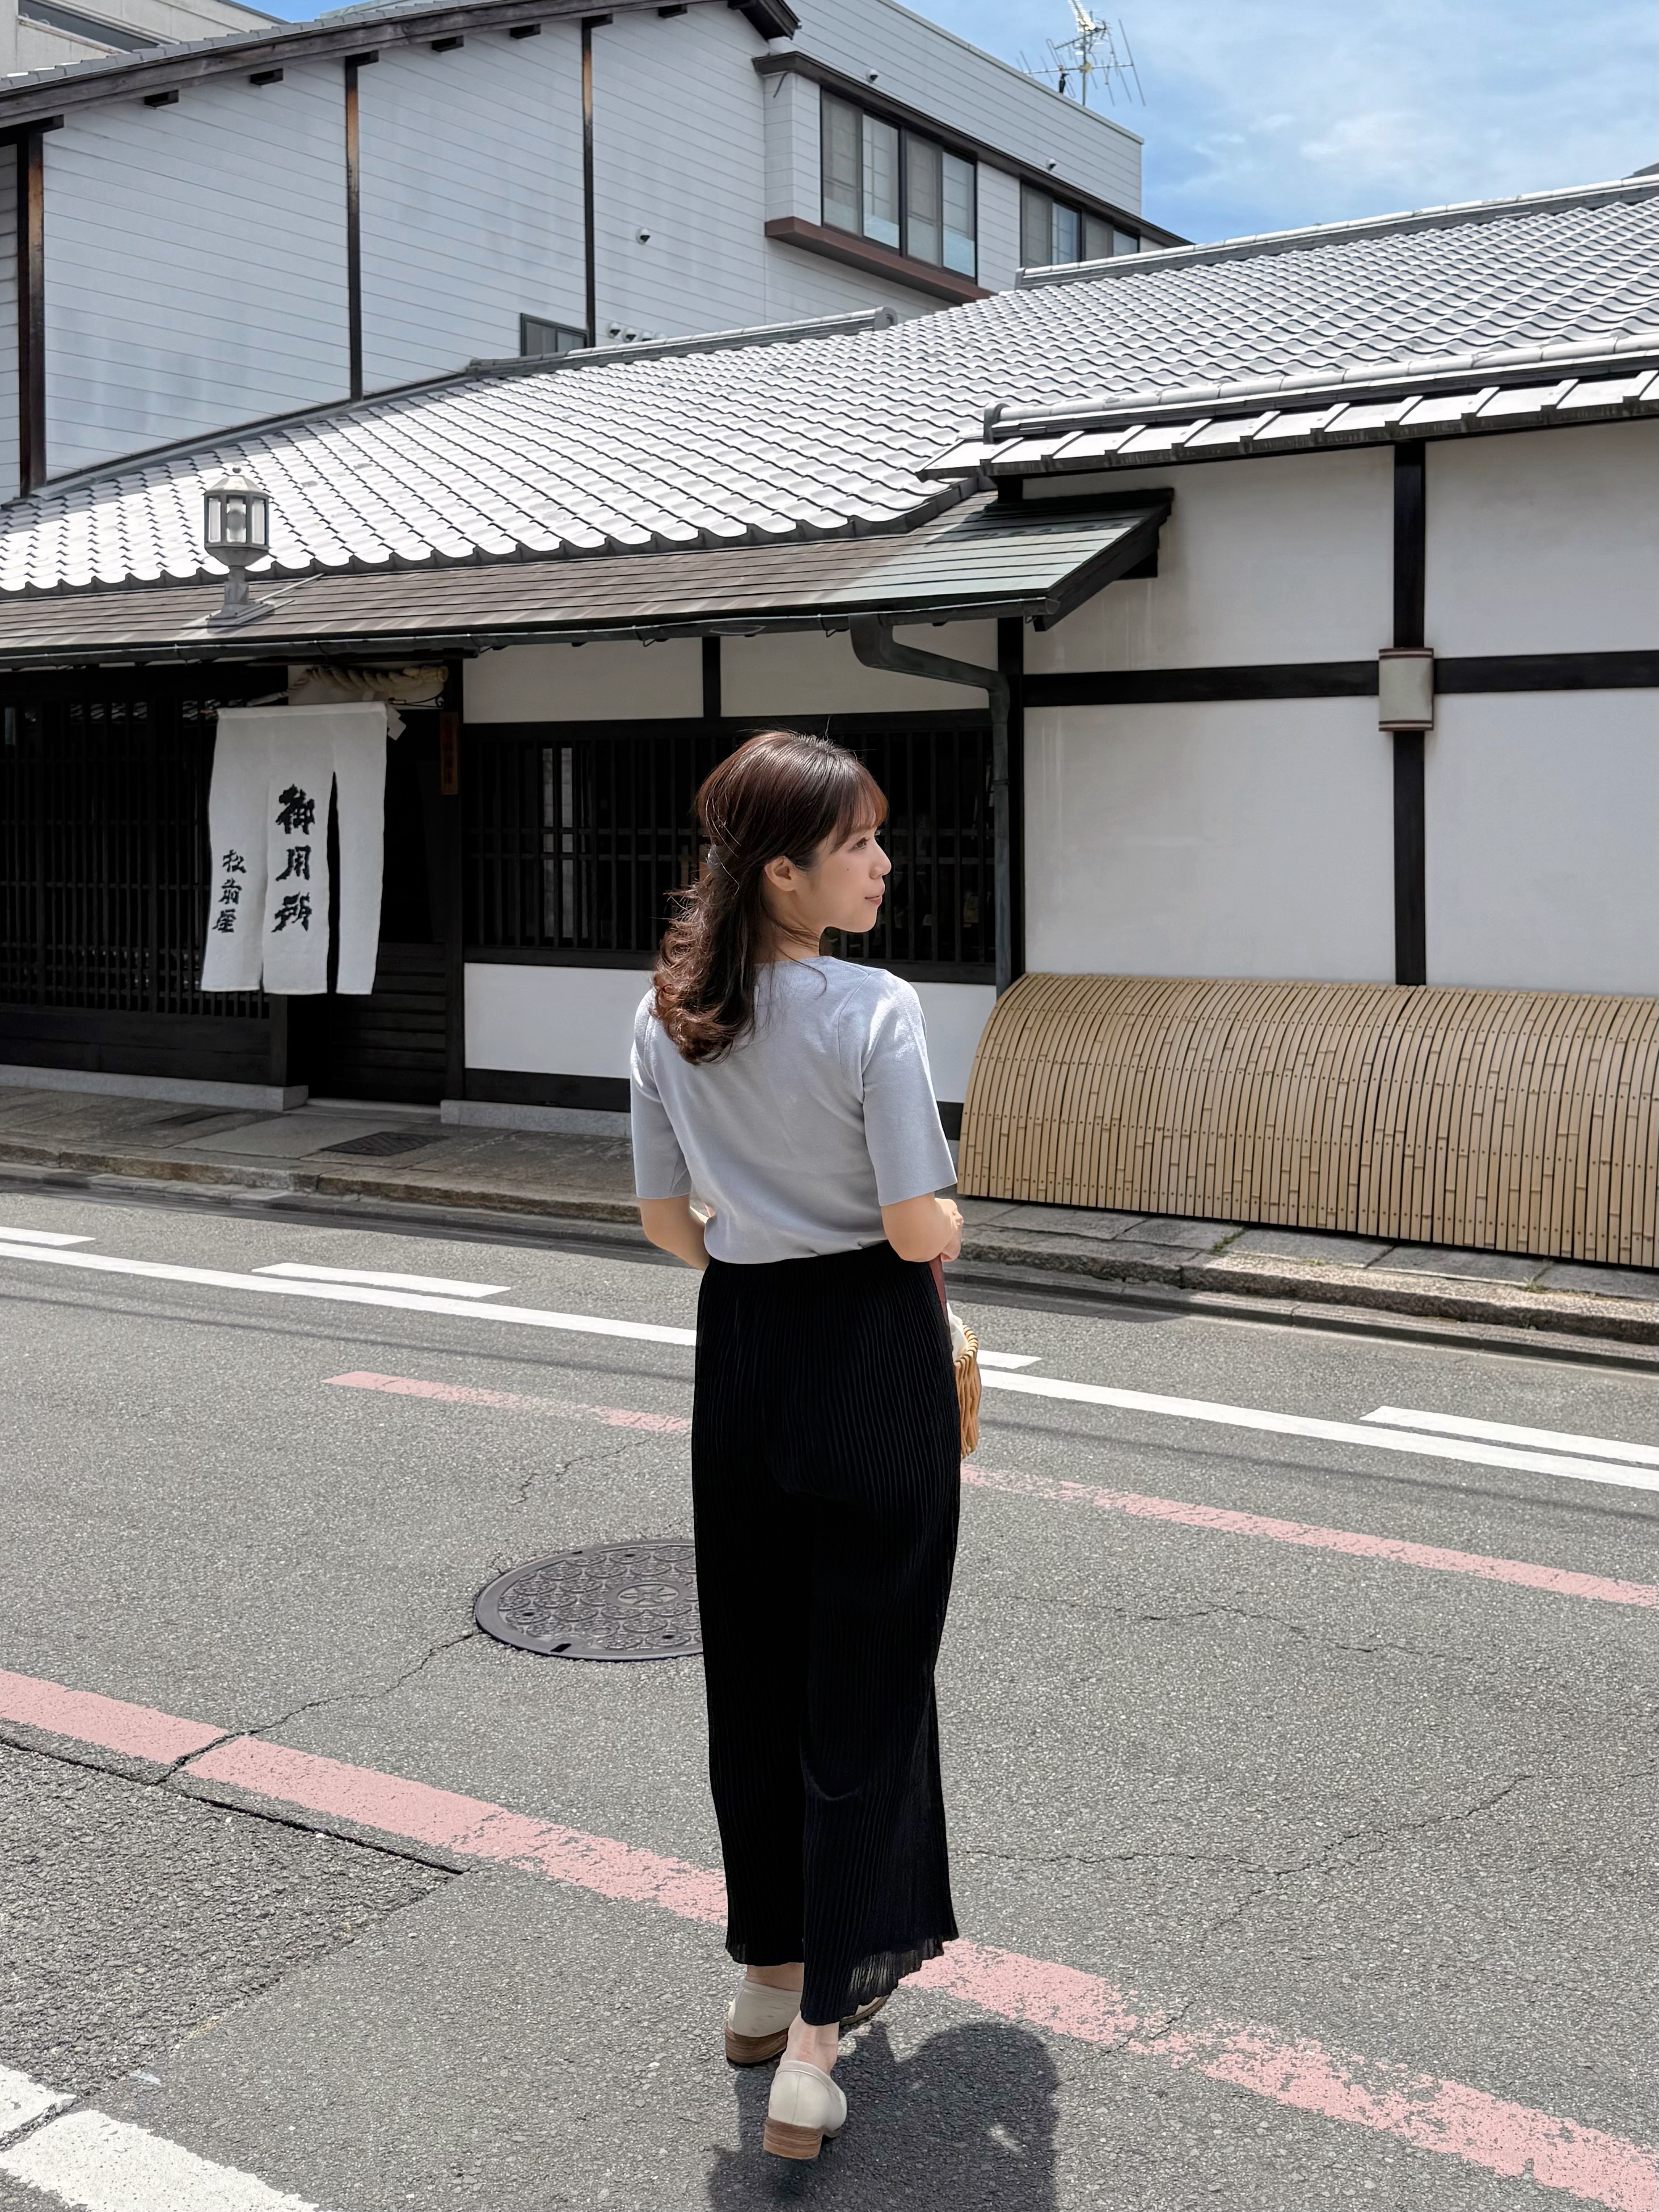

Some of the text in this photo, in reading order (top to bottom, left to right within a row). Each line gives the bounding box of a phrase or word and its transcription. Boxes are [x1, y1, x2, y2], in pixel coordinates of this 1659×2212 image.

[212, 849, 247, 933] 松前屋
[271, 783, 315, 933] 御用所
